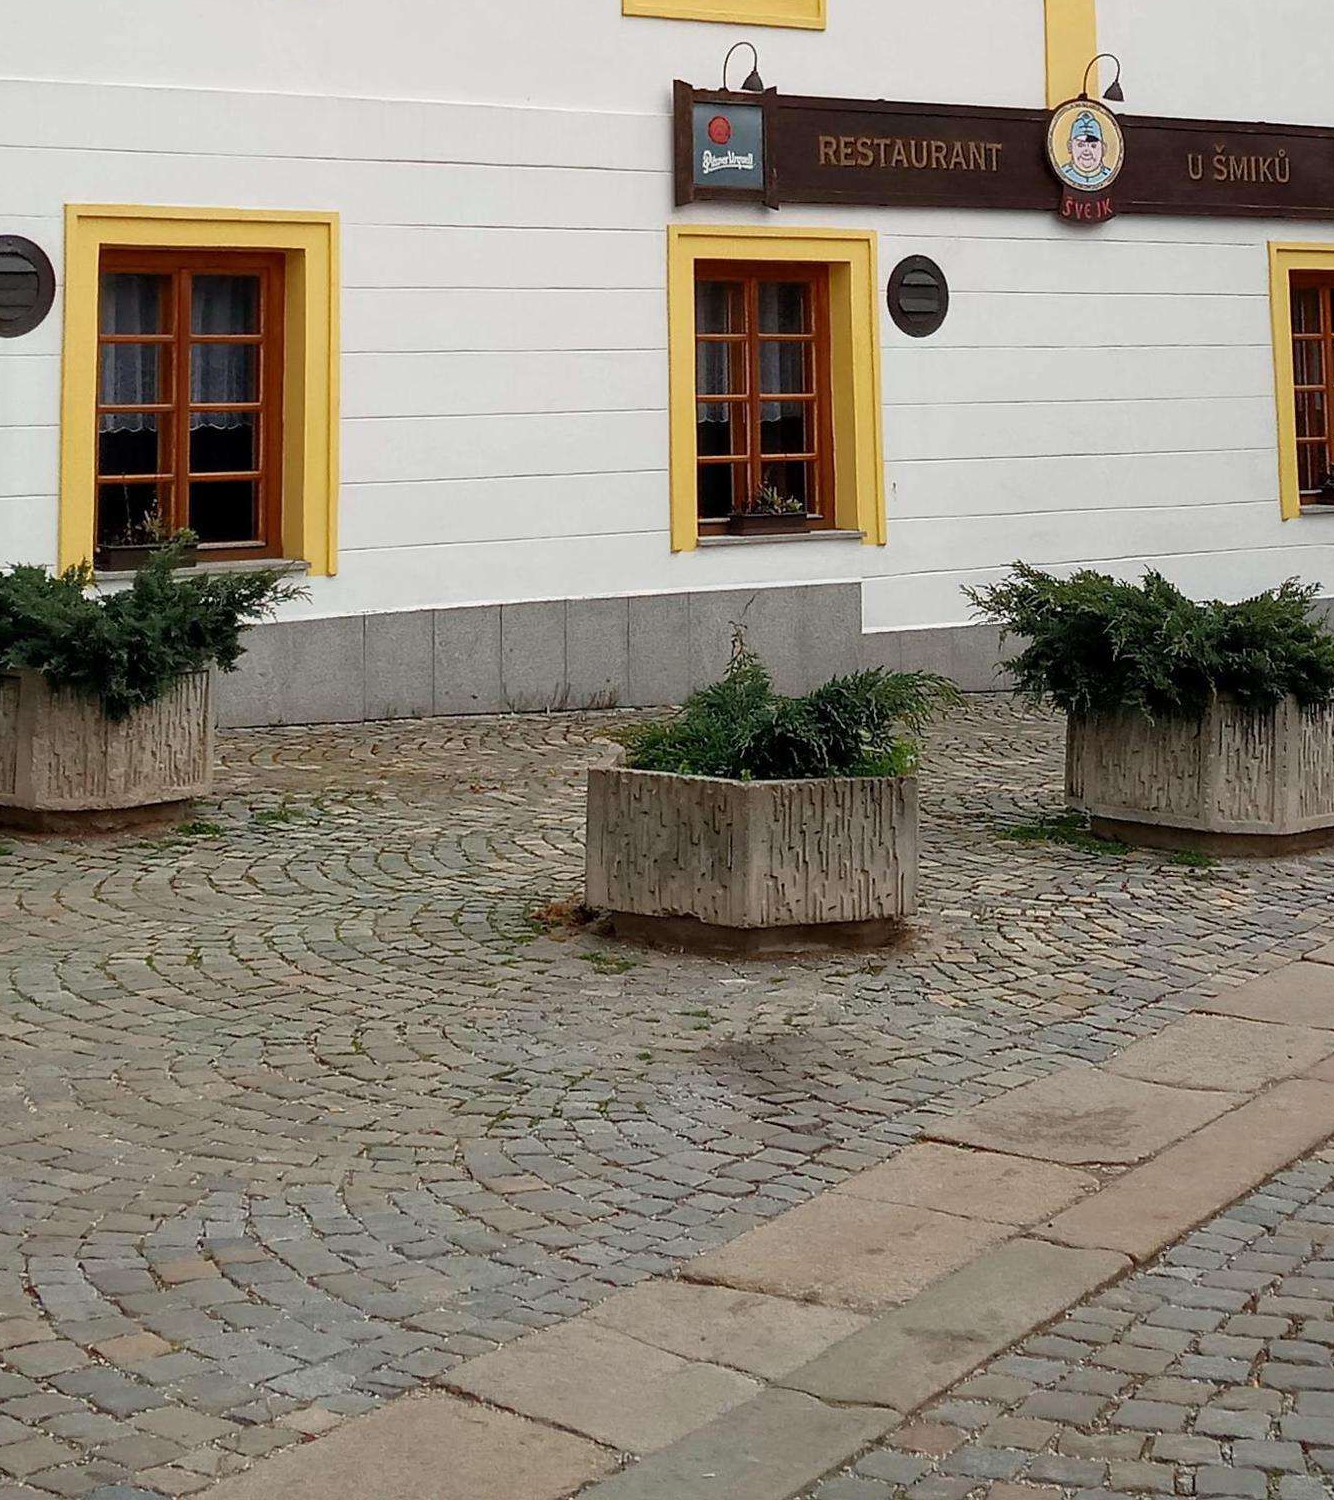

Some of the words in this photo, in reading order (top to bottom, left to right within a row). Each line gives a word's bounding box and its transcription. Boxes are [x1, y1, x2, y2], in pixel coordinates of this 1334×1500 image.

[818, 135, 1003, 172] RESTAURANT
[1187, 153, 1204, 180] U
[1213, 143, 1291, 183] ŠMIKŮ
[1061, 196, 1113, 219] ŠVEJK
